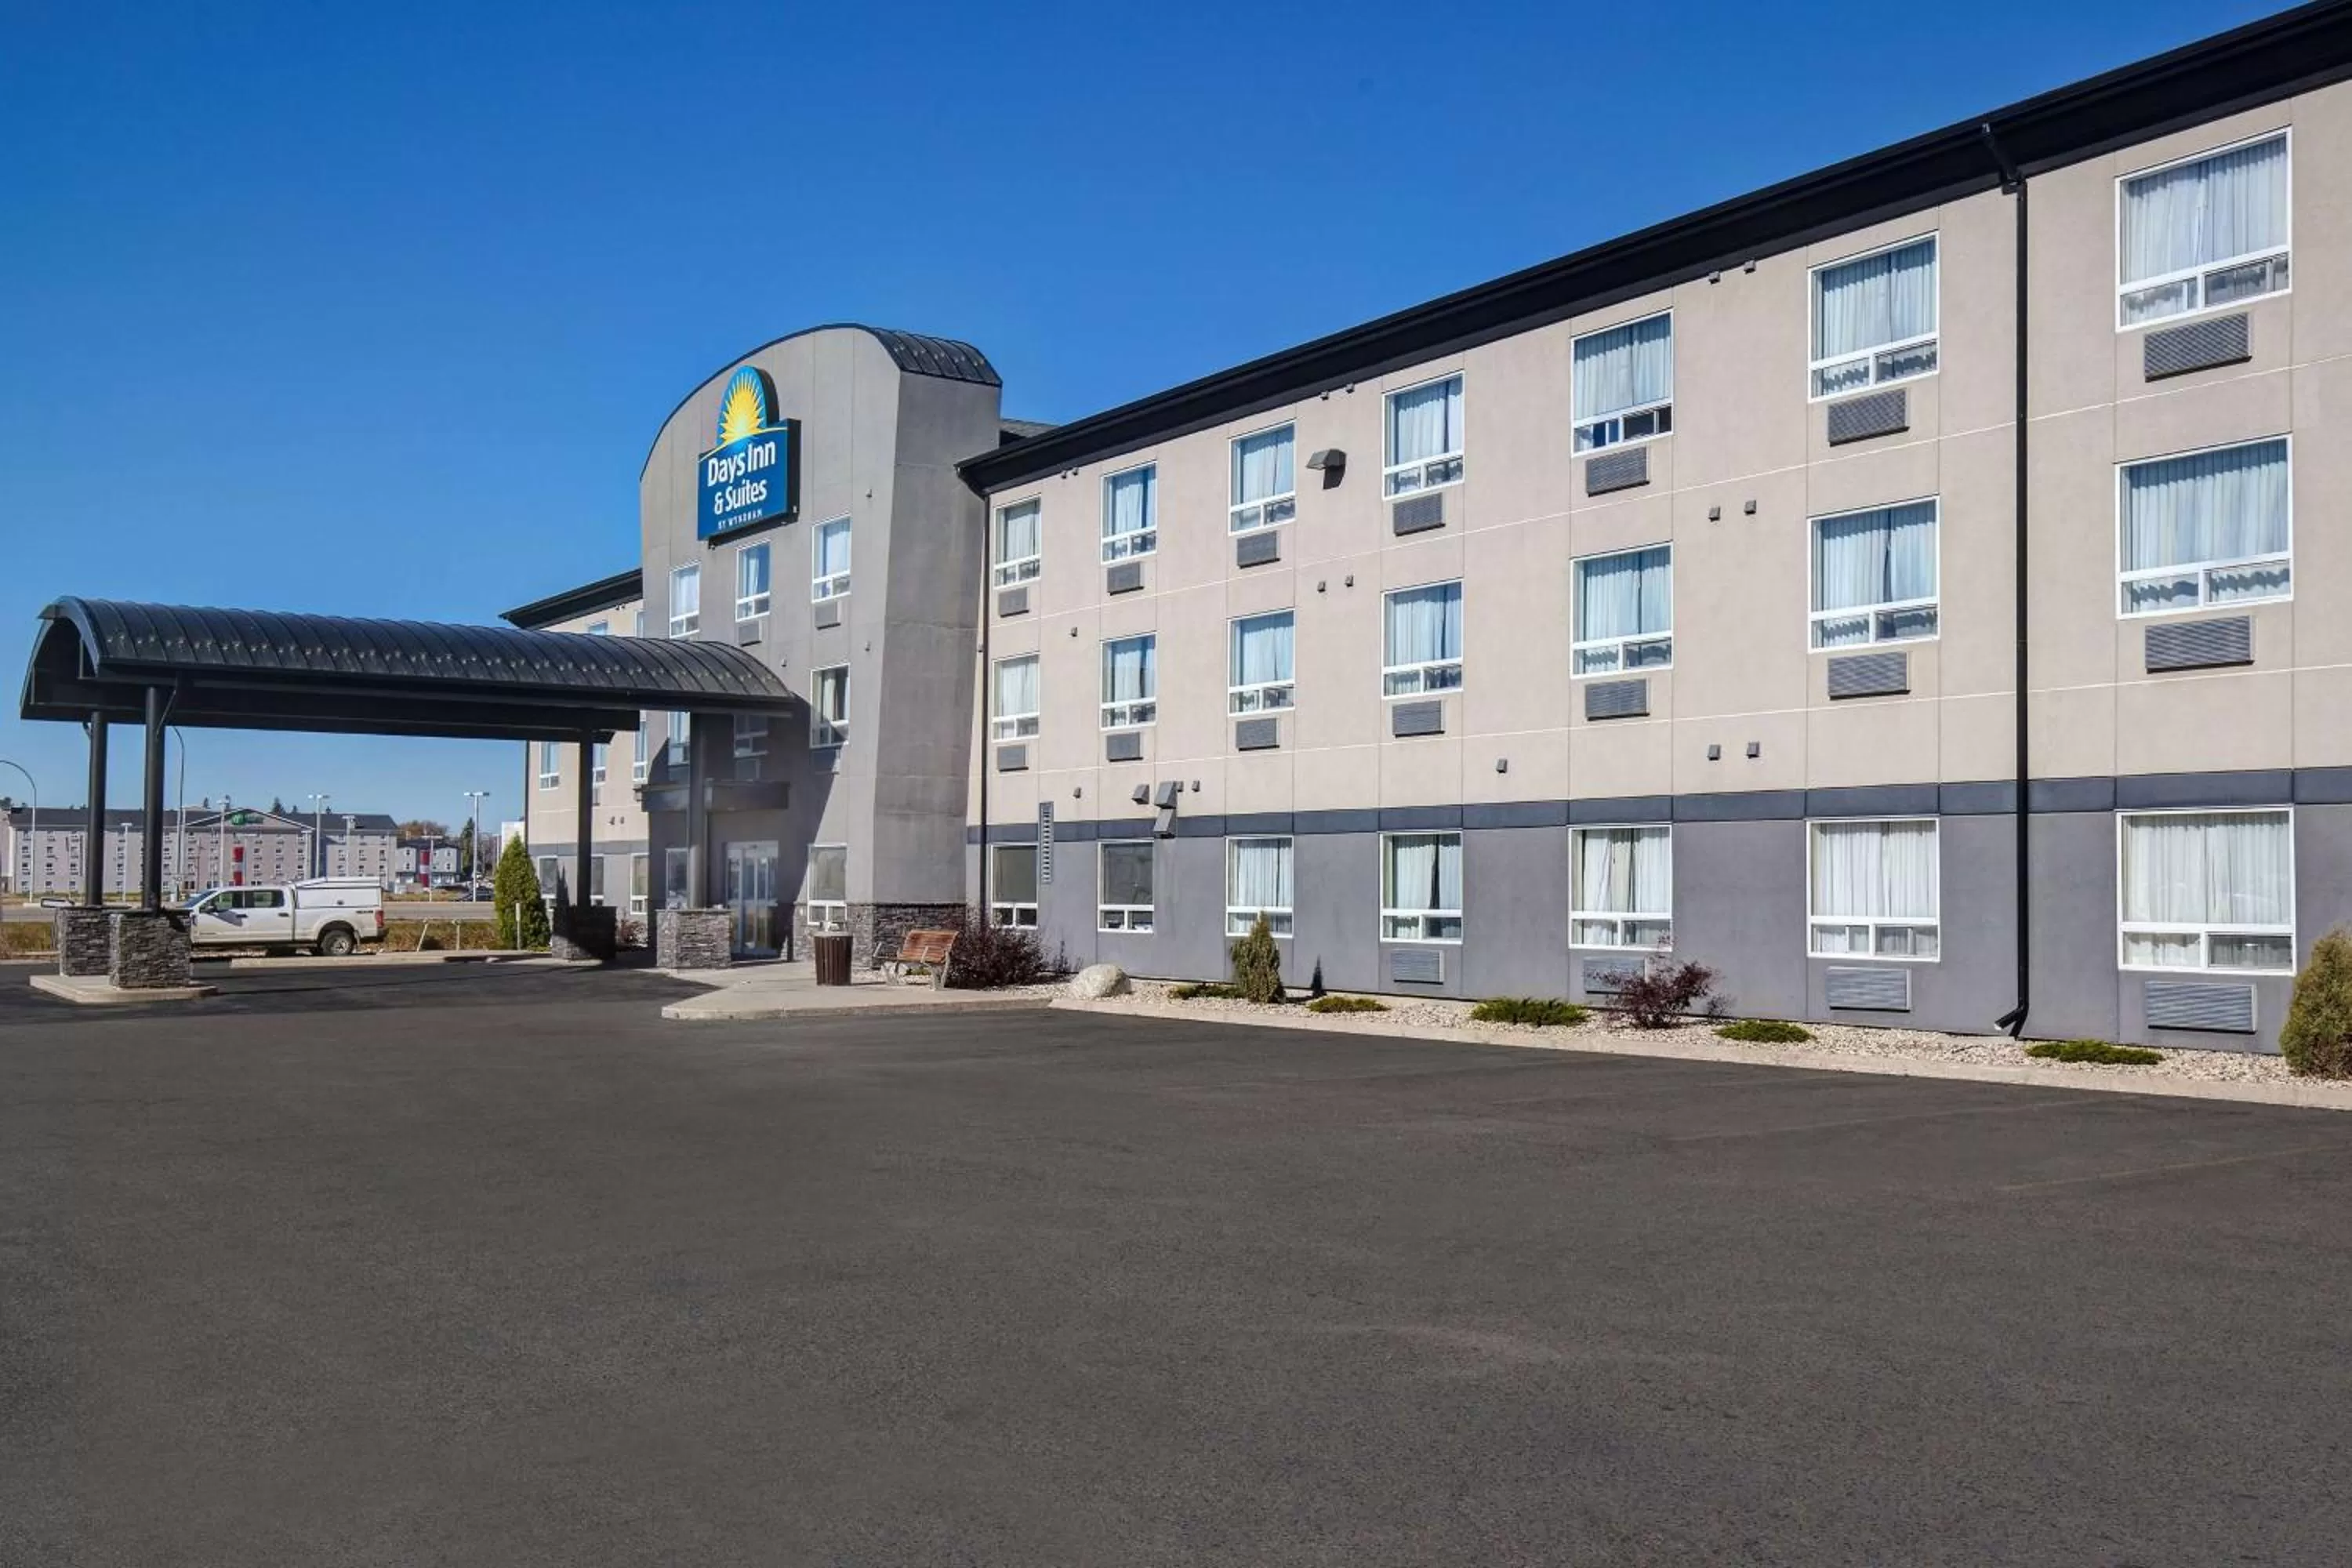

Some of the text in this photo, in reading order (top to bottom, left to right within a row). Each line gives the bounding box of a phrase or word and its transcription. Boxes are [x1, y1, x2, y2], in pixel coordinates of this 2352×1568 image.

[707, 441, 775, 487] Days Inn
[714, 479, 768, 515] & Suites
